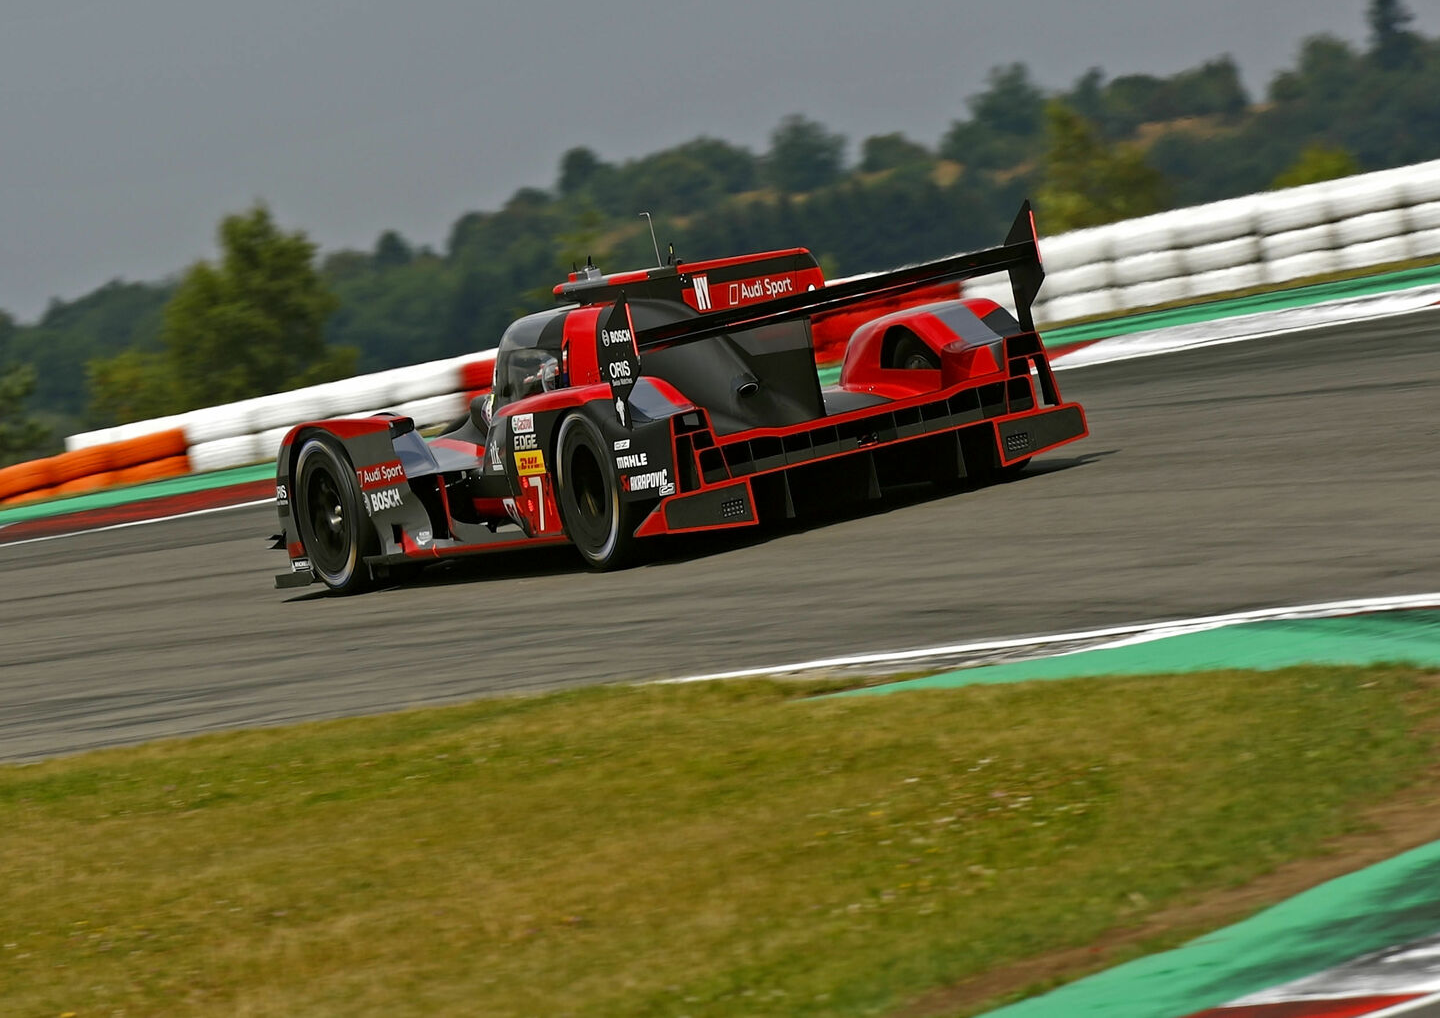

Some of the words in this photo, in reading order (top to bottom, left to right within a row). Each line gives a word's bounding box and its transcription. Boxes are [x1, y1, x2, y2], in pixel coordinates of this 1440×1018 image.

[741, 280, 764, 299] Audi
[764, 277, 793, 298] Sport
[609, 329, 631, 343] BOSCH
[609, 360, 631, 378] ORIS
[513, 433, 538, 450] EDGE
[520, 456, 540, 470] DHL
[616, 452, 648, 469] MAHLE
[363, 469, 382, 482] Audi
[382, 463, 403, 482] Sport
[370, 488, 403, 512] BOSCH
[528, 476, 545, 531] 7
